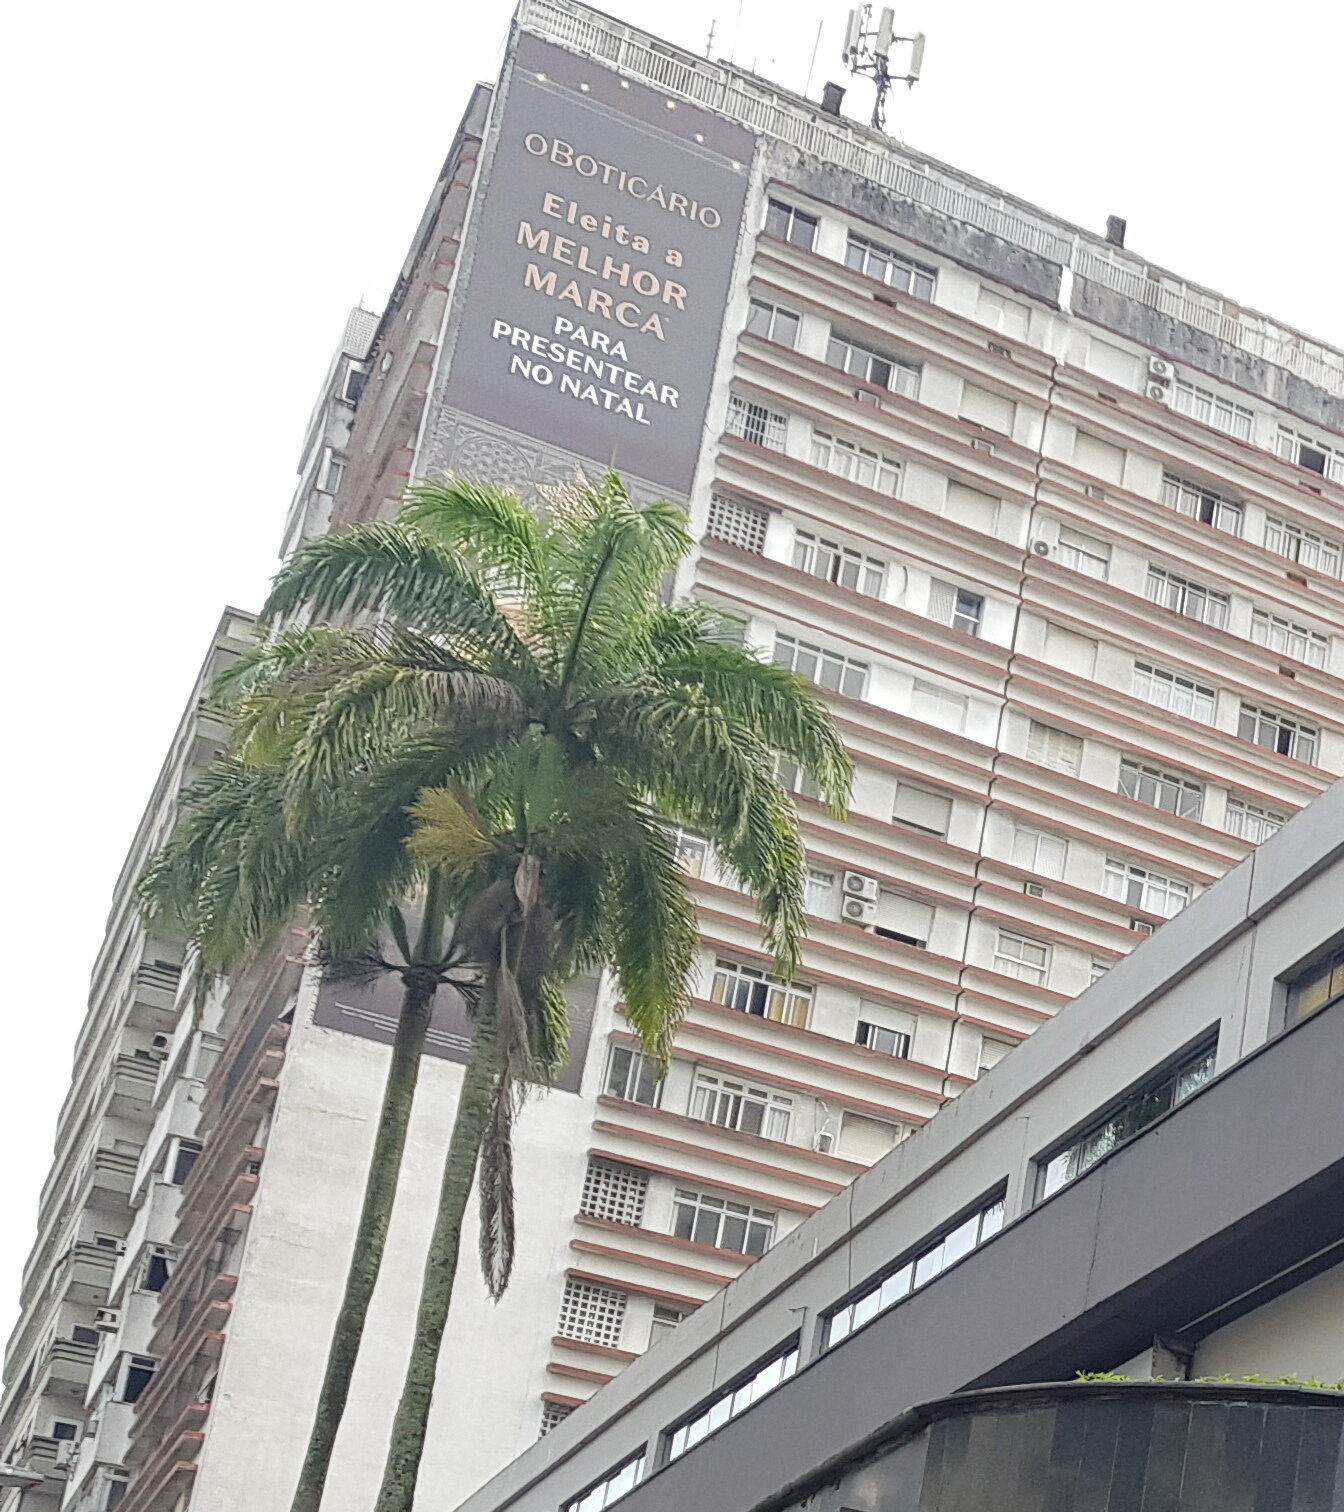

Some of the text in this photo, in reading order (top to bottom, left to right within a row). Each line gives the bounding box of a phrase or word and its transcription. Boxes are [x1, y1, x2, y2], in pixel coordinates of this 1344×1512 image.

[516, 221, 687, 311] MELHOR
[542, 192, 683, 268] Eleita a
[524, 263, 665, 341] MARCA
[554, 316, 629, 362] PARA
[492, 319, 680, 409] PRESENTEAR
[510, 355, 650, 425] NO NATAL
